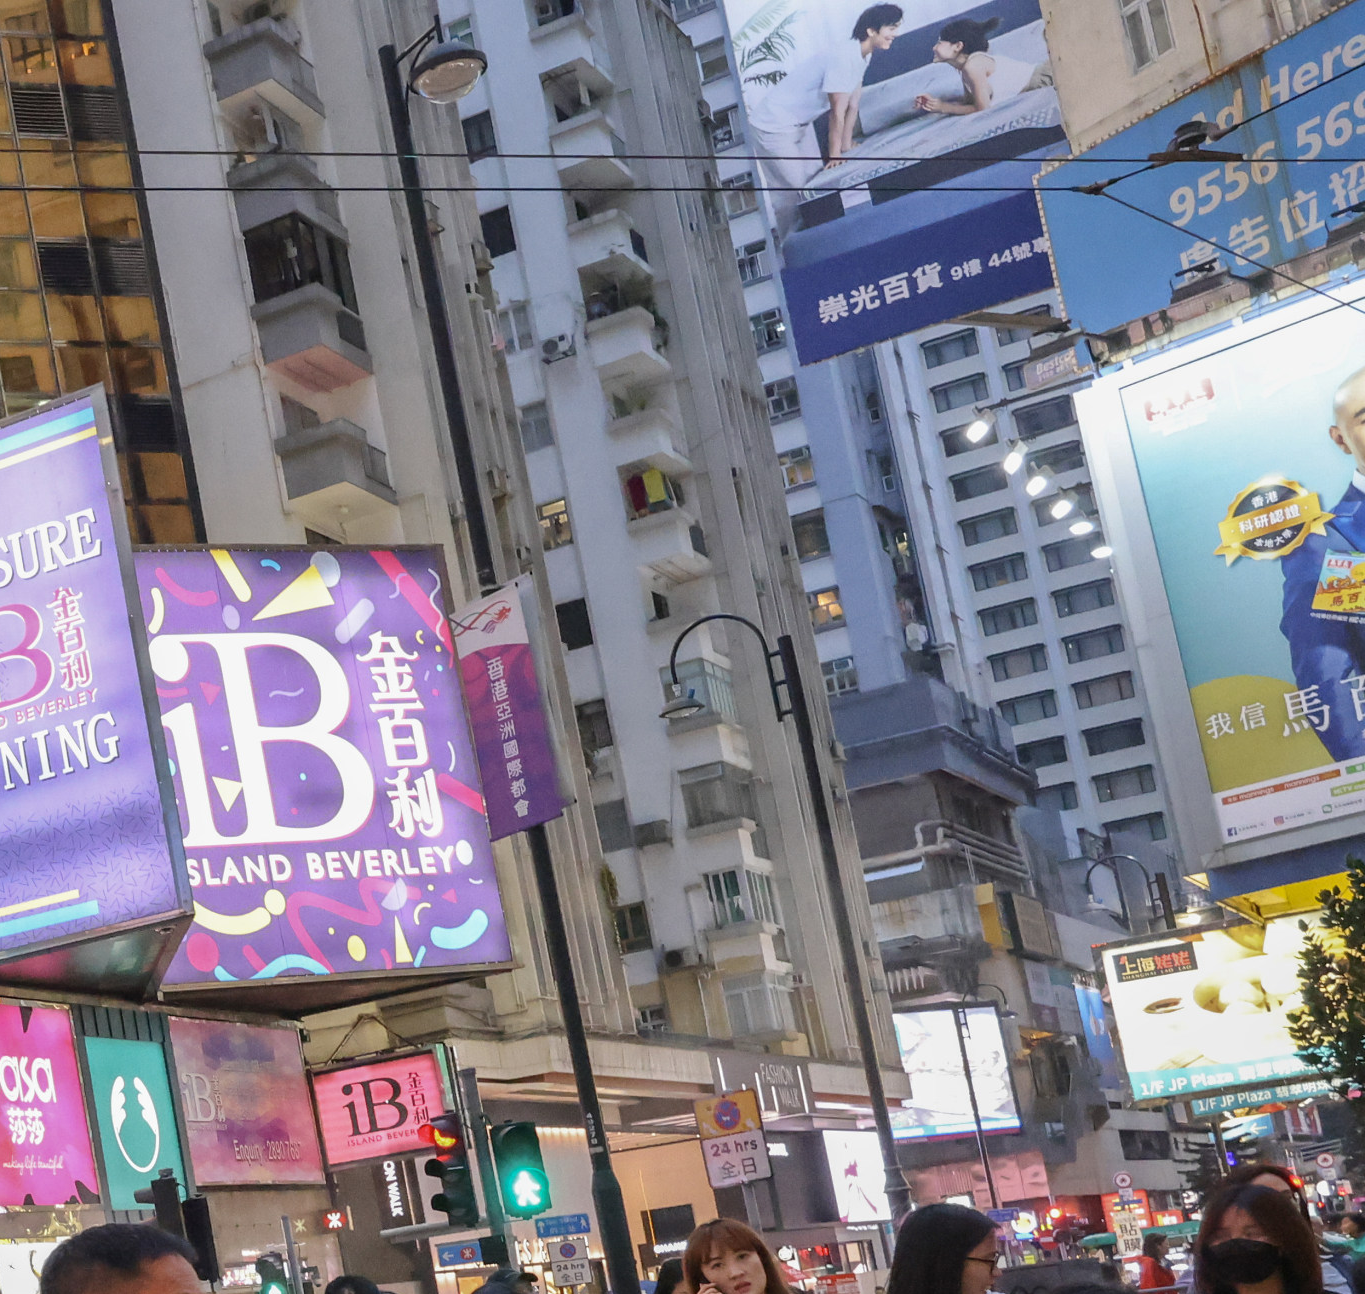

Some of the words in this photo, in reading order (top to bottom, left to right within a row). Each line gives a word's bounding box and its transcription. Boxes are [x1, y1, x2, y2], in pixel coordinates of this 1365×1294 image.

[1169, 141, 1278, 227] 9556
[818, 262, 943, 324] 崇光百貨
[950, 258, 982, 281] 9樓
[1251, 490, 1279, 508] 香港
[1239, 504, 1301, 534] 科研認證
[47, 586, 93, 692] 金百利
[16, 688, 98, 726] BEVERLEY
[1205, 702, 1267, 739] 我信
[356, 630, 444, 839] 金百利
[486, 656, 531, 819] 香港亞洲國際都會
[186, 853, 293, 888] SLAND
[306, 845, 457, 880] BEVERLEY
[1122, 950, 1191, 976] 上海姥姥
[1122, 971, 1156, 981] SHANGHAI
[760, 1063, 794, 1085] FASHION
[1140, 1080, 1165, 1096] 1/F
[1168, 1077, 1187, 1092] JP
[1191, 1070, 1235, 1088] Plaza
[407, 1072, 430, 1126] 金百利
[778, 1087, 800, 1108] WALK
[1199, 1099, 1217, 1112] 1/F
[1220, 1096, 1235, 1109] JP
[1237, 1089, 1272, 1105] Plaza
[7, 1107, 45, 1145] 莎莎
[347, 1131, 383, 1147] ISLAND
[387, 1127, 418, 1141] BEVER
[711, 1142, 731, 1157] 24
[734, 1139, 758, 1152] hrs
[721, 1157, 758, 1180] 全日
[387, 1182, 404, 1217] WALK
[1119, 1223, 1142, 1252] 貼膜
[556, 1264, 568, 1273] 24
[570, 1262, 585, 1271] hrs
[561, 1272, 584, 1283] 全日
